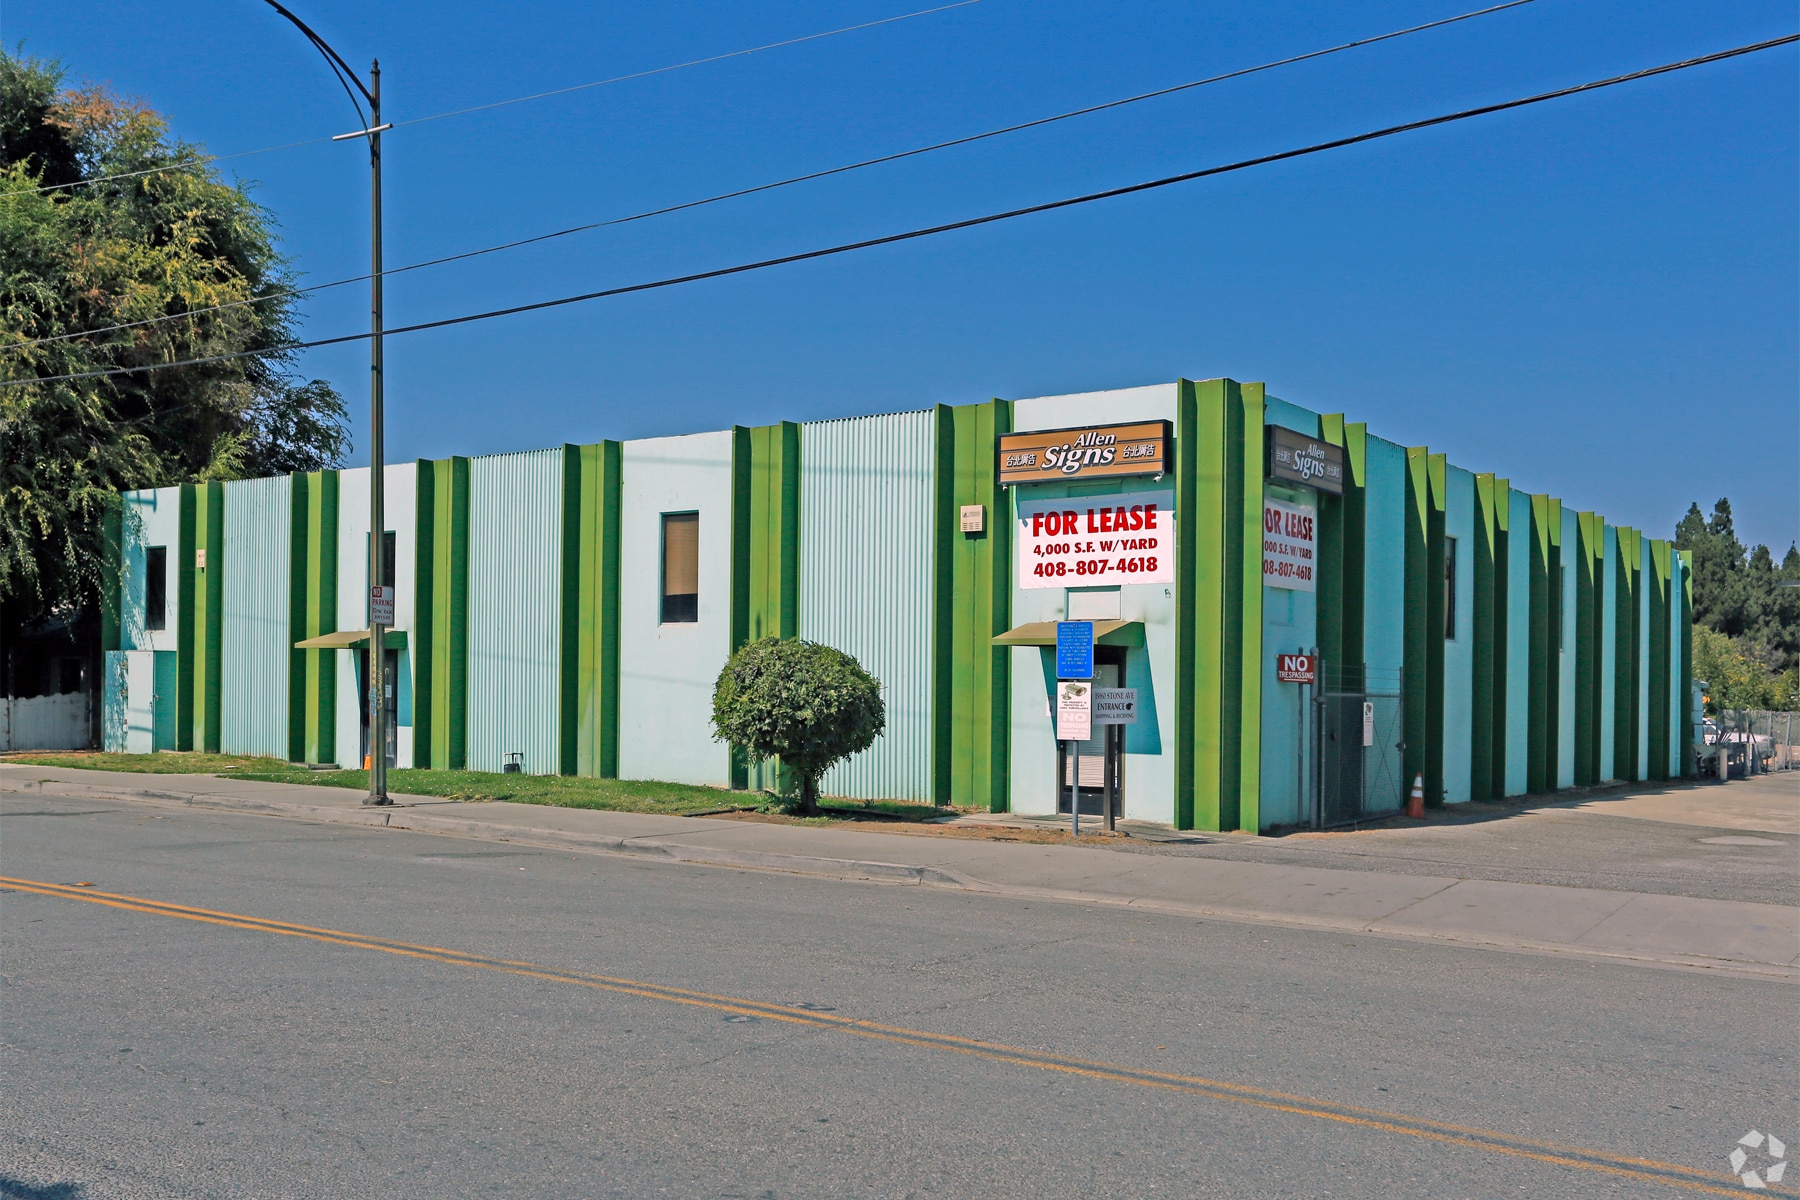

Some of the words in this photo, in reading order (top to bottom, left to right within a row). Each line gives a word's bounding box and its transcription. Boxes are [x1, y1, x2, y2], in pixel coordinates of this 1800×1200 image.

[1074, 432, 1116, 447] Allen
[1041, 444, 1116, 473] Signs
[1307, 443, 1325, 460] Allen
[1292, 449, 1325, 479] Signs
[1033, 510, 1079, 537] FOR
[1087, 503, 1157, 534] LEASE
[1264, 507, 1282, 535] OR
[1285, 512, 1313, 542] LEASE
[1033, 542, 1070, 558] 4,000
[1074, 541, 1096, 554] S.F.
[1100, 537, 1158, 552] W/YARD
[1264, 540, 1278, 553] 000
[1279, 543, 1289, 556] S.F.
[1290, 545, 1312, 560] W/YARD
[1033, 556, 1158, 578] 408-807-4618
[1263, 559, 1312, 581] 08-807-4618
[373, 587, 381, 597] NO
[372, 598, 393, 607] PARKING
[1284, 656, 1309, 672] NO
[1278, 671, 1314, 679] TRESPASSING
[1106, 692, 1123, 700] STONE
[1124, 691, 1134, 699] AVE
[1097, 702, 1125, 711] ENTRANCE
[1062, 712, 1086, 722] NO
